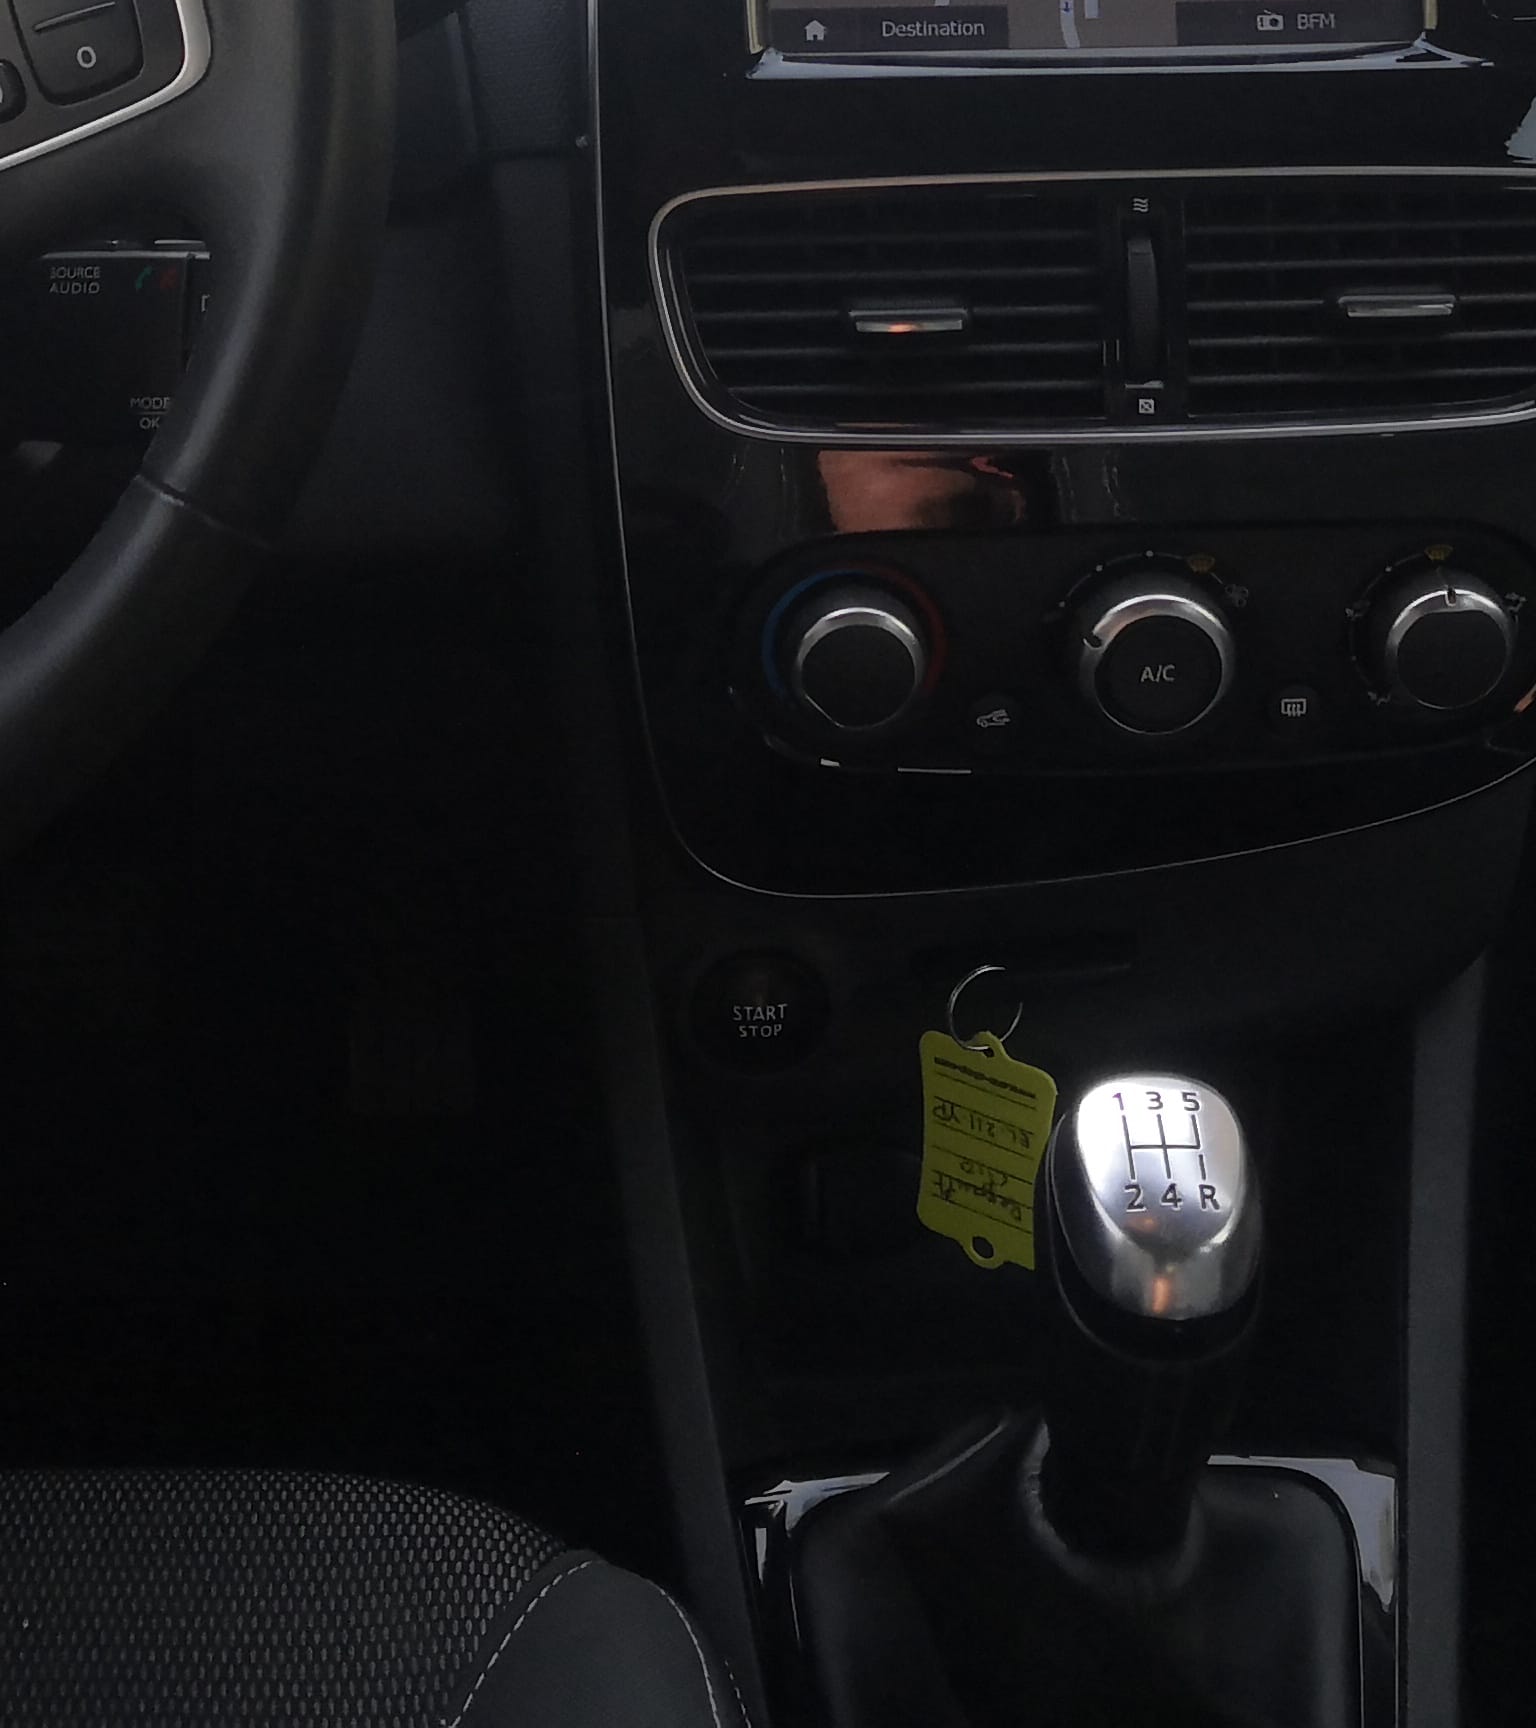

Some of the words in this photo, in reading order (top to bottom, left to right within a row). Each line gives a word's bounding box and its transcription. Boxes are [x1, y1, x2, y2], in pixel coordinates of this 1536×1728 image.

[881, 19, 986, 38] Destination
[1296, 12, 1336, 30] BFM
[48, 265, 101, 280] SOURCE
[48, 281, 101, 295] AUDIO
[138, 416, 162, 430] OK
[1140, 663, 1176, 684] A/C
[731, 1002, 789, 1022] START
[737, 1022, 784, 1039] STOP
[1111, 1091, 1125, 1112] 1
[1144, 1090, 1165, 1111] 3
[1181, 1090, 1201, 1112] 5
[1124, 1183, 1148, 1212] 2
[1160, 1183, 1183, 1211] 4
[1198, 1183, 1221, 1211] R
